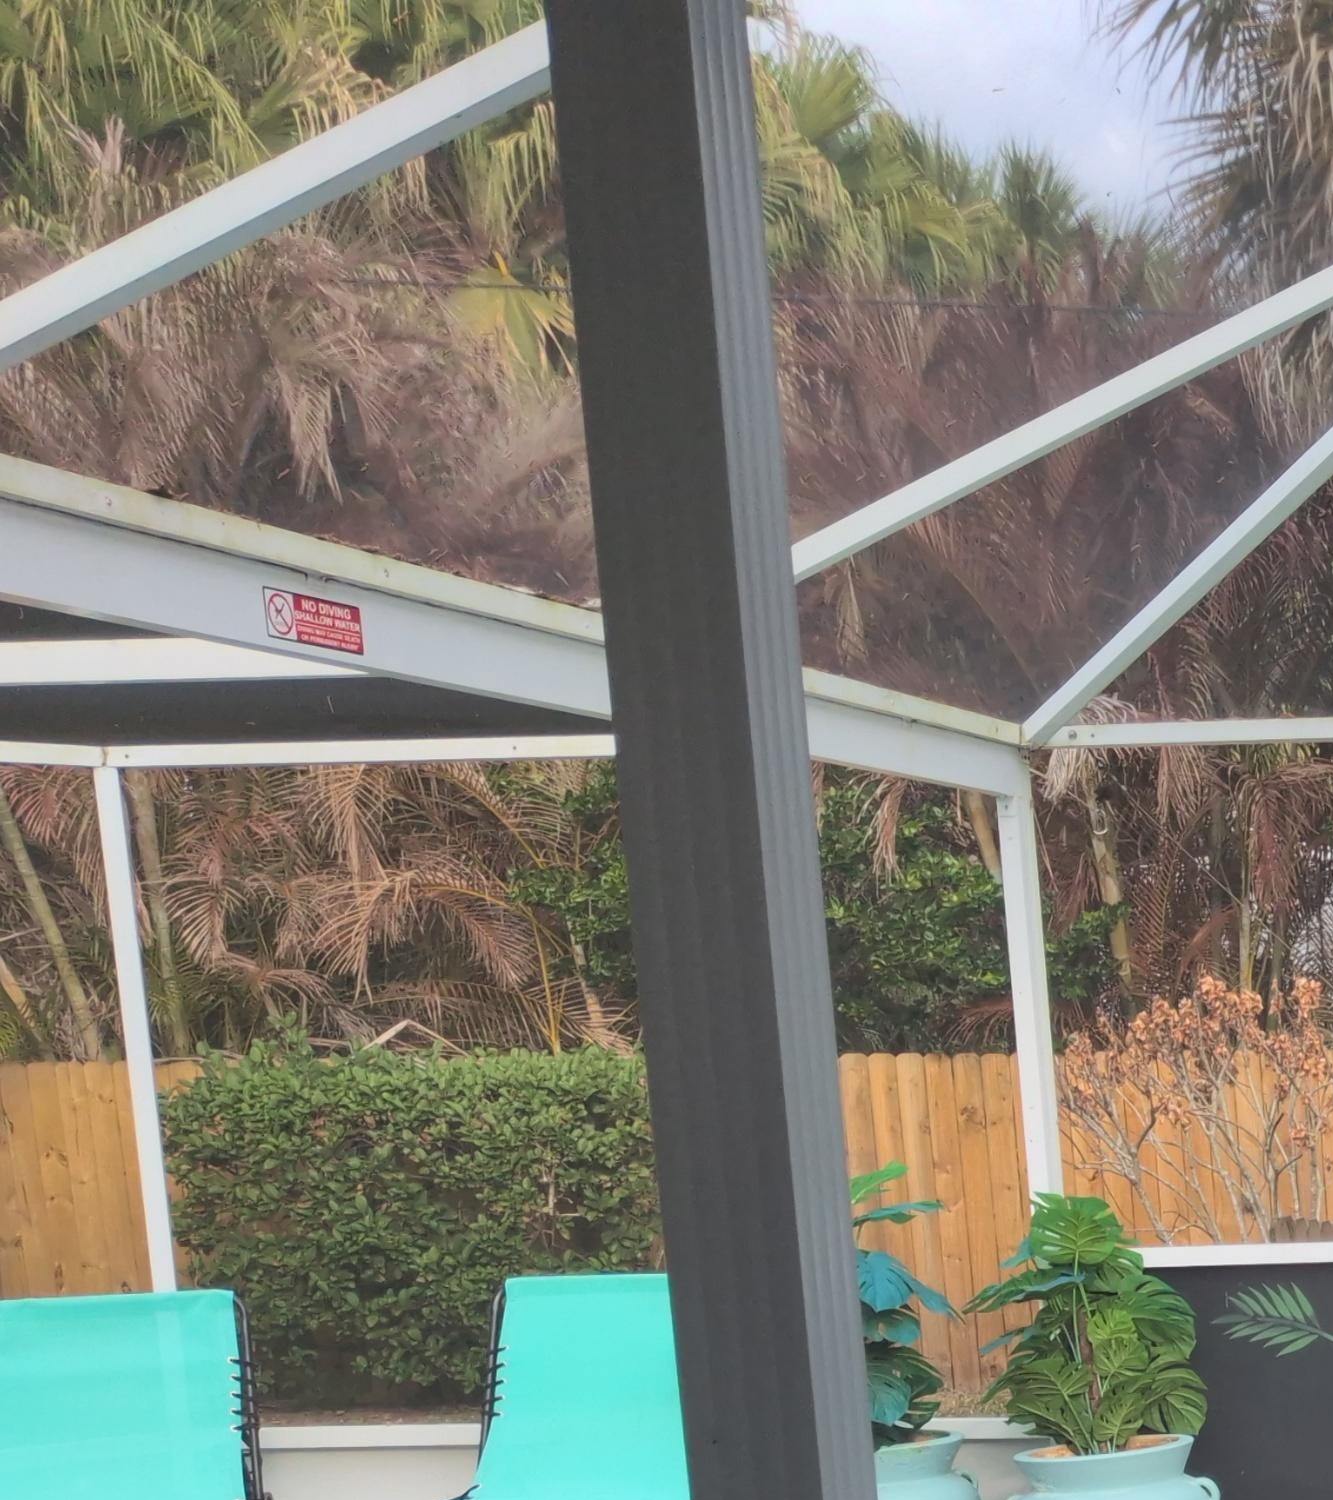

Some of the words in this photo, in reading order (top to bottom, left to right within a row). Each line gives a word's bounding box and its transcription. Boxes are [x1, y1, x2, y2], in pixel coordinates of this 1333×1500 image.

[301, 599, 316, 612] NO
[319, 603, 351, 619] DIVING
[294, 611, 333, 626] SHALLOW
[334, 619, 361, 632] WATER
